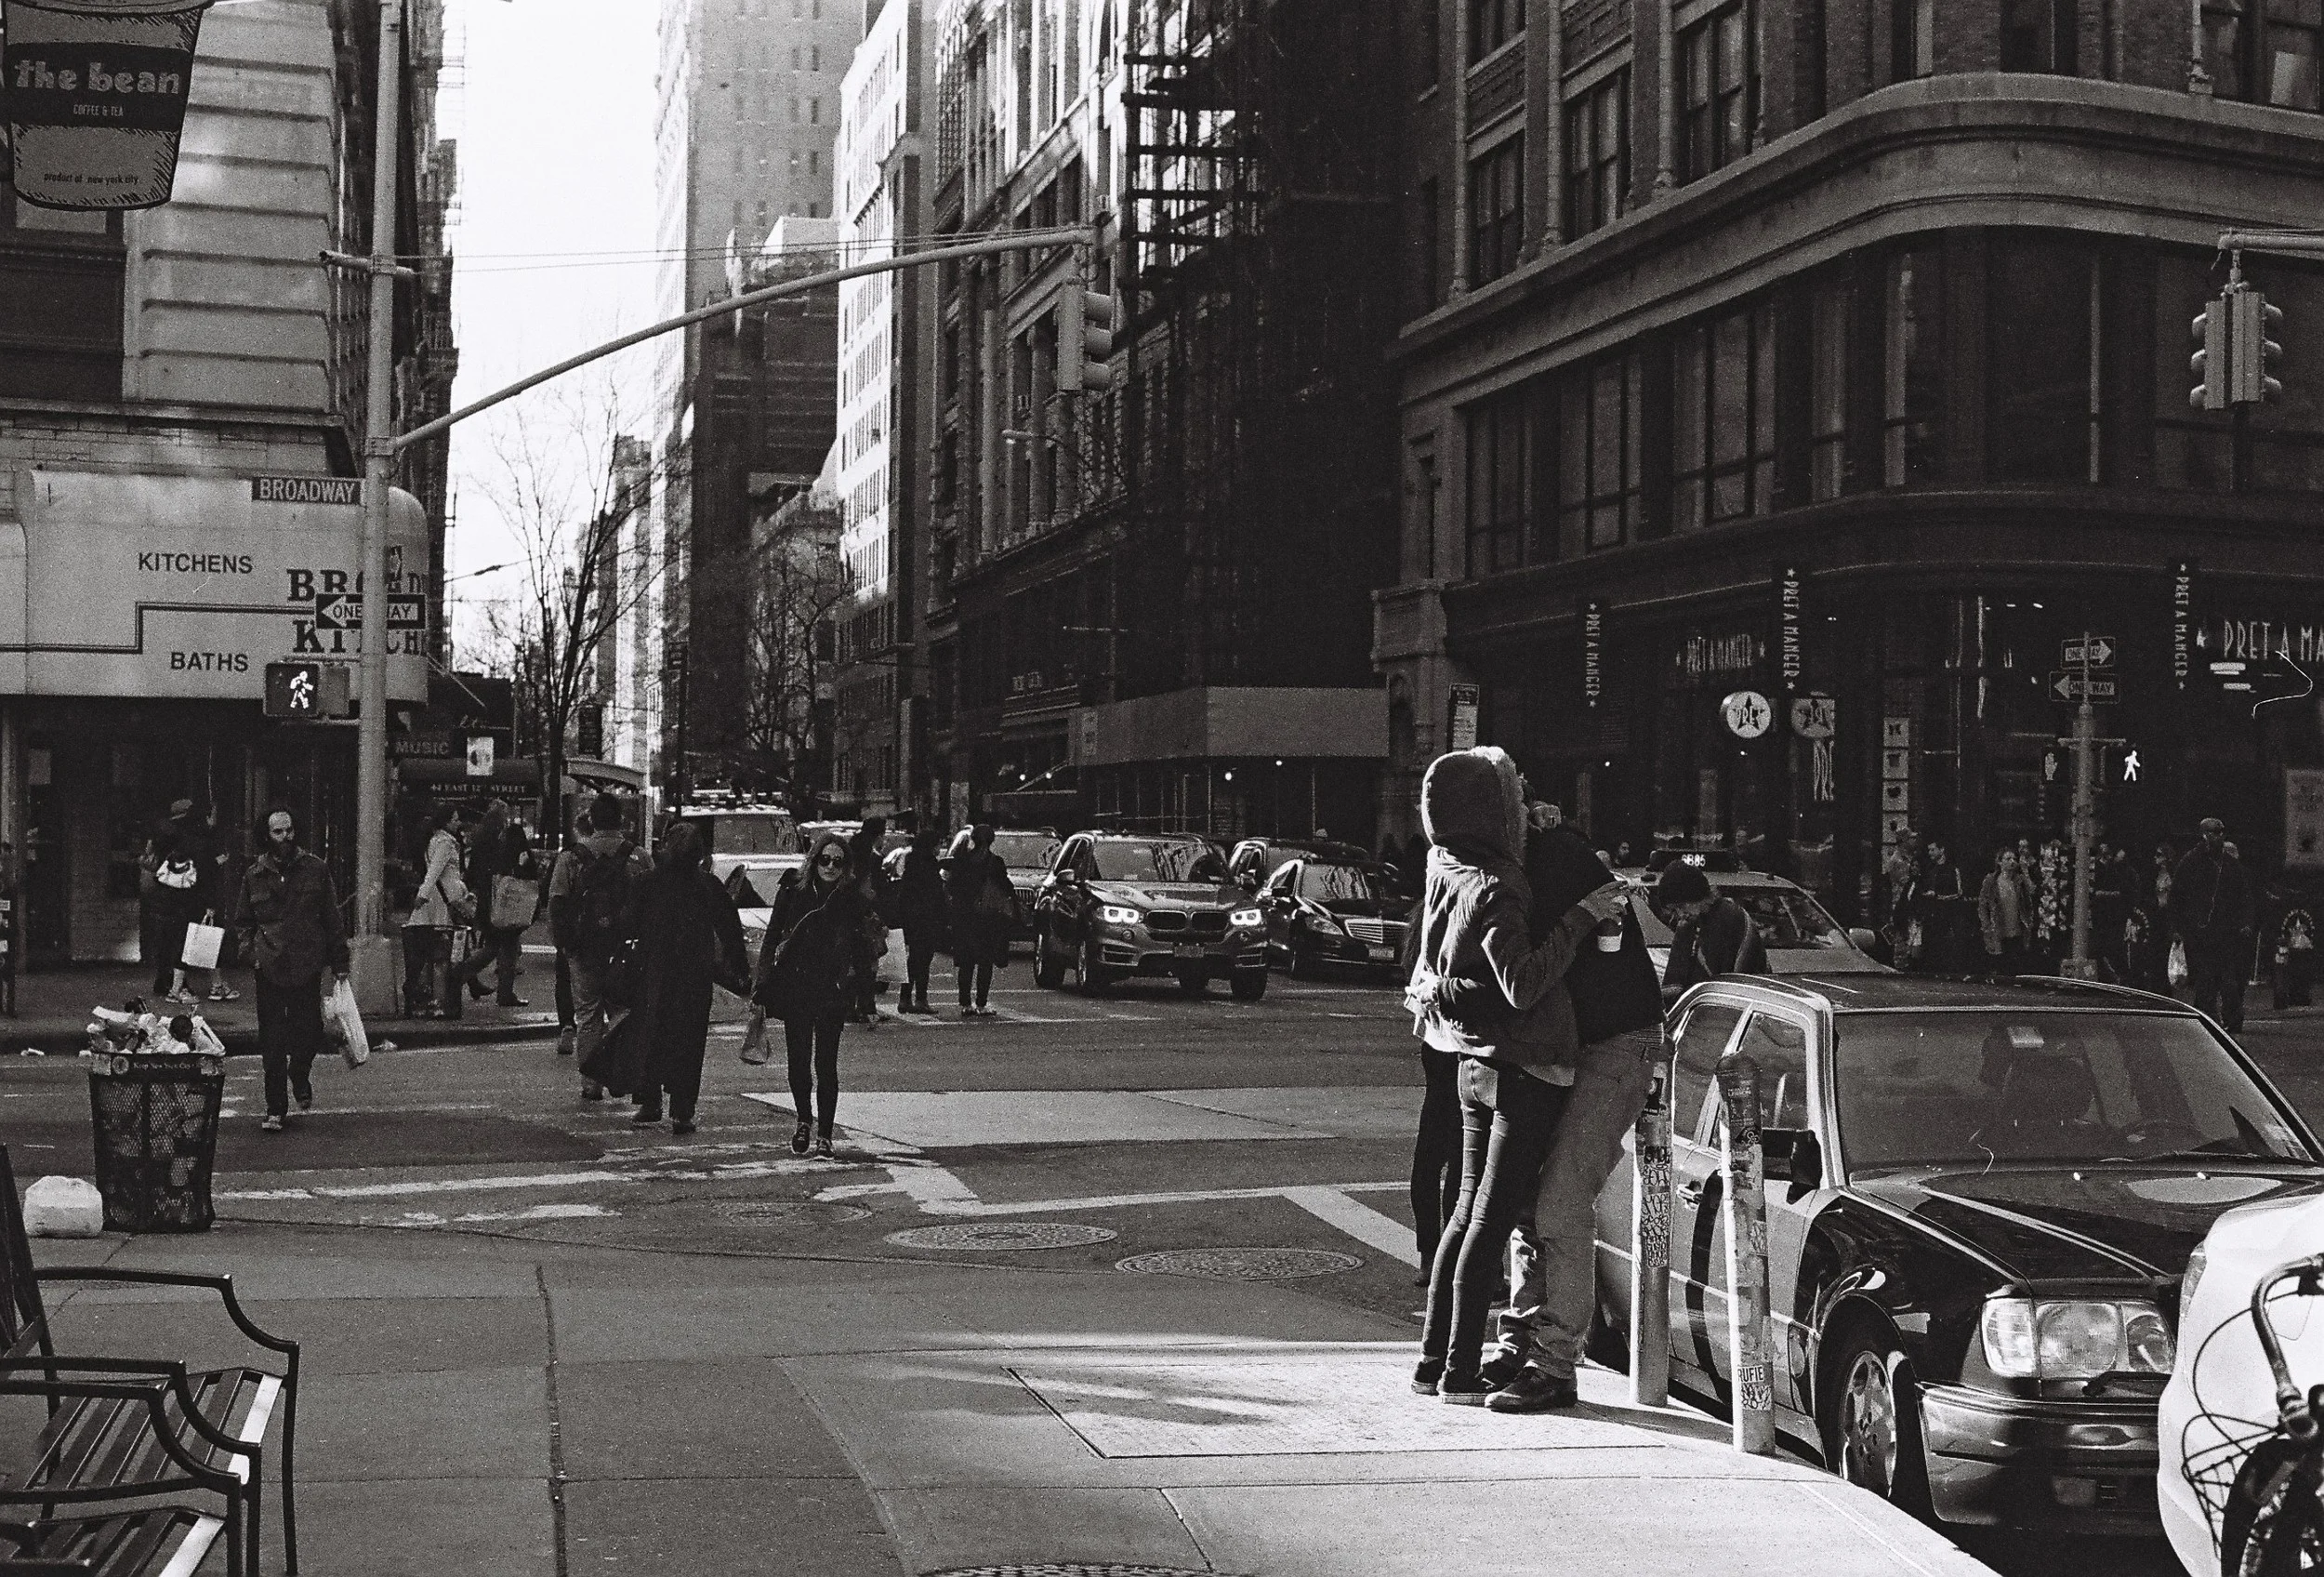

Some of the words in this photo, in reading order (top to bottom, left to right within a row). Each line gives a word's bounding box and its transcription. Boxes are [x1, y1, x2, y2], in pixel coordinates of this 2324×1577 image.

[14, 60, 77, 91] the
[88, 61, 179, 94] bean
[73, 103, 99, 116] COFFEE
[102, 104, 108, 116] &
[111, 105, 124, 117] TEA
[44, 172, 73, 182] product
[74, 175, 83, 183] of
[87, 175, 103, 184] new
[105, 174, 123, 186] york
[125, 175, 139, 186] city
[259, 478, 355, 503] BROADWAY
[139, 551, 254, 575] KITCHENS
[1783, 580, 1801, 610] PRET
[2174, 576, 2189, 605] PRET
[332, 604, 363, 618] ONE
[387, 604, 412, 618] AY
[1783, 612, 1799, 621] A
[2174, 609, 2187, 618] A
[1585, 614, 1600, 637] PRET
[2223, 618, 2271, 660] PRET
[2279, 623, 2291, 660] A
[170, 652, 249, 672] BATHS
[1782, 626, 1801, 678] MANGER
